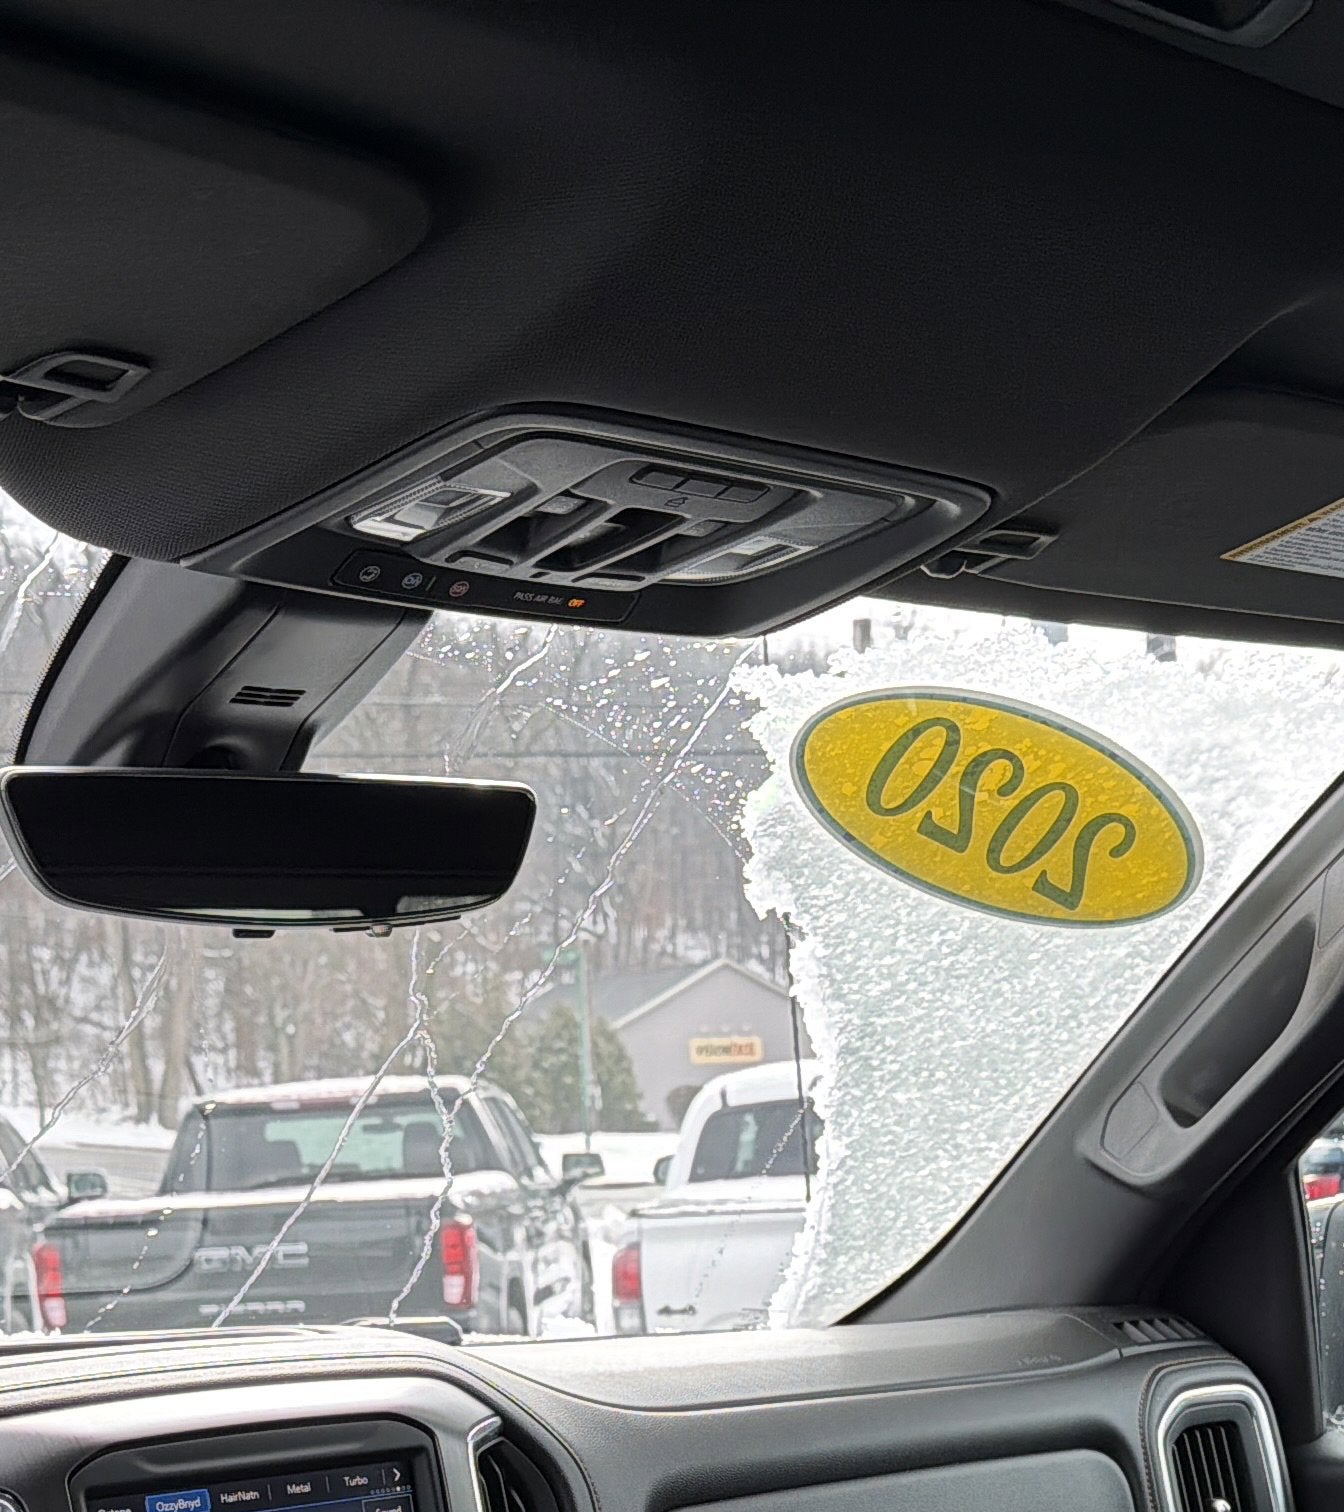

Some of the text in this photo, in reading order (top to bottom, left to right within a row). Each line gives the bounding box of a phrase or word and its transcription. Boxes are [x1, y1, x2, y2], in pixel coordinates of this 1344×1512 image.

[513, 591, 535, 602] PASS
[194, 1242, 309, 1272] GMC
[220, 1490, 260, 1503] HairNatn
[286, 1482, 312, 1495] Metal
[343, 1476, 369, 1488] Turbo
